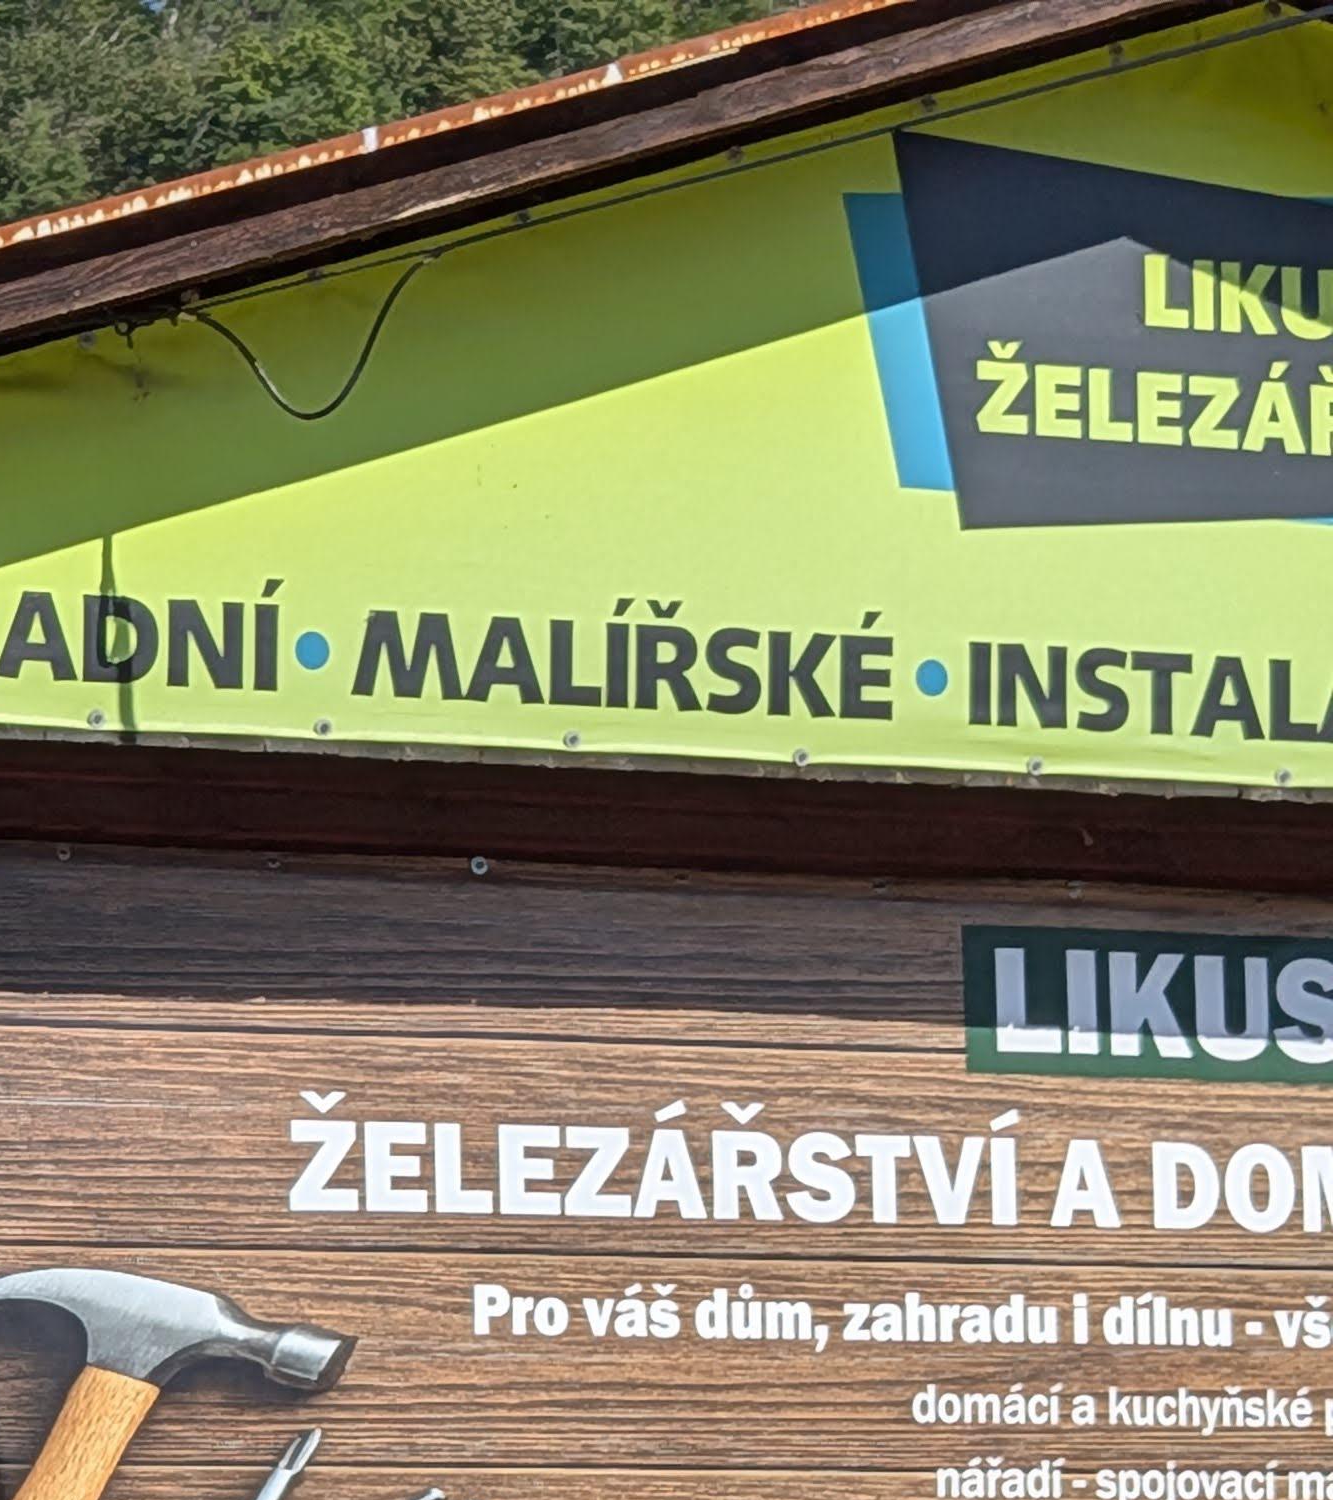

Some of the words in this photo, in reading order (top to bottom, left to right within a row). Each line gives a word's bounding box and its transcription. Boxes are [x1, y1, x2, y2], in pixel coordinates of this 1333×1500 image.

[349, 597, 895, 722] MALÍŘSKÉ
[966, 640, 1333, 744] INSTAL
[286, 1090, 1022, 1227] ŽELEZÁŘSTVÍ
[1049, 1138, 1122, 1230] A
[471, 1283, 570, 1338] Pro
[582, 1281, 681, 1340] váš
[694, 1286, 829, 1353] dům,
[842, 1291, 1059, 1346] zahradu
[1072, 1293, 1090, 1346] i
[1101, 1294, 1234, 1348] dílnu
[1273, 1294, 1333, 1350] vš
[911, 1383, 1061, 1428] domácí
[1070, 1396, 1098, 1428] a
[1107, 1383, 1315, 1438] kuchyňské
[935, 1456, 1063, 1500] nářadí
